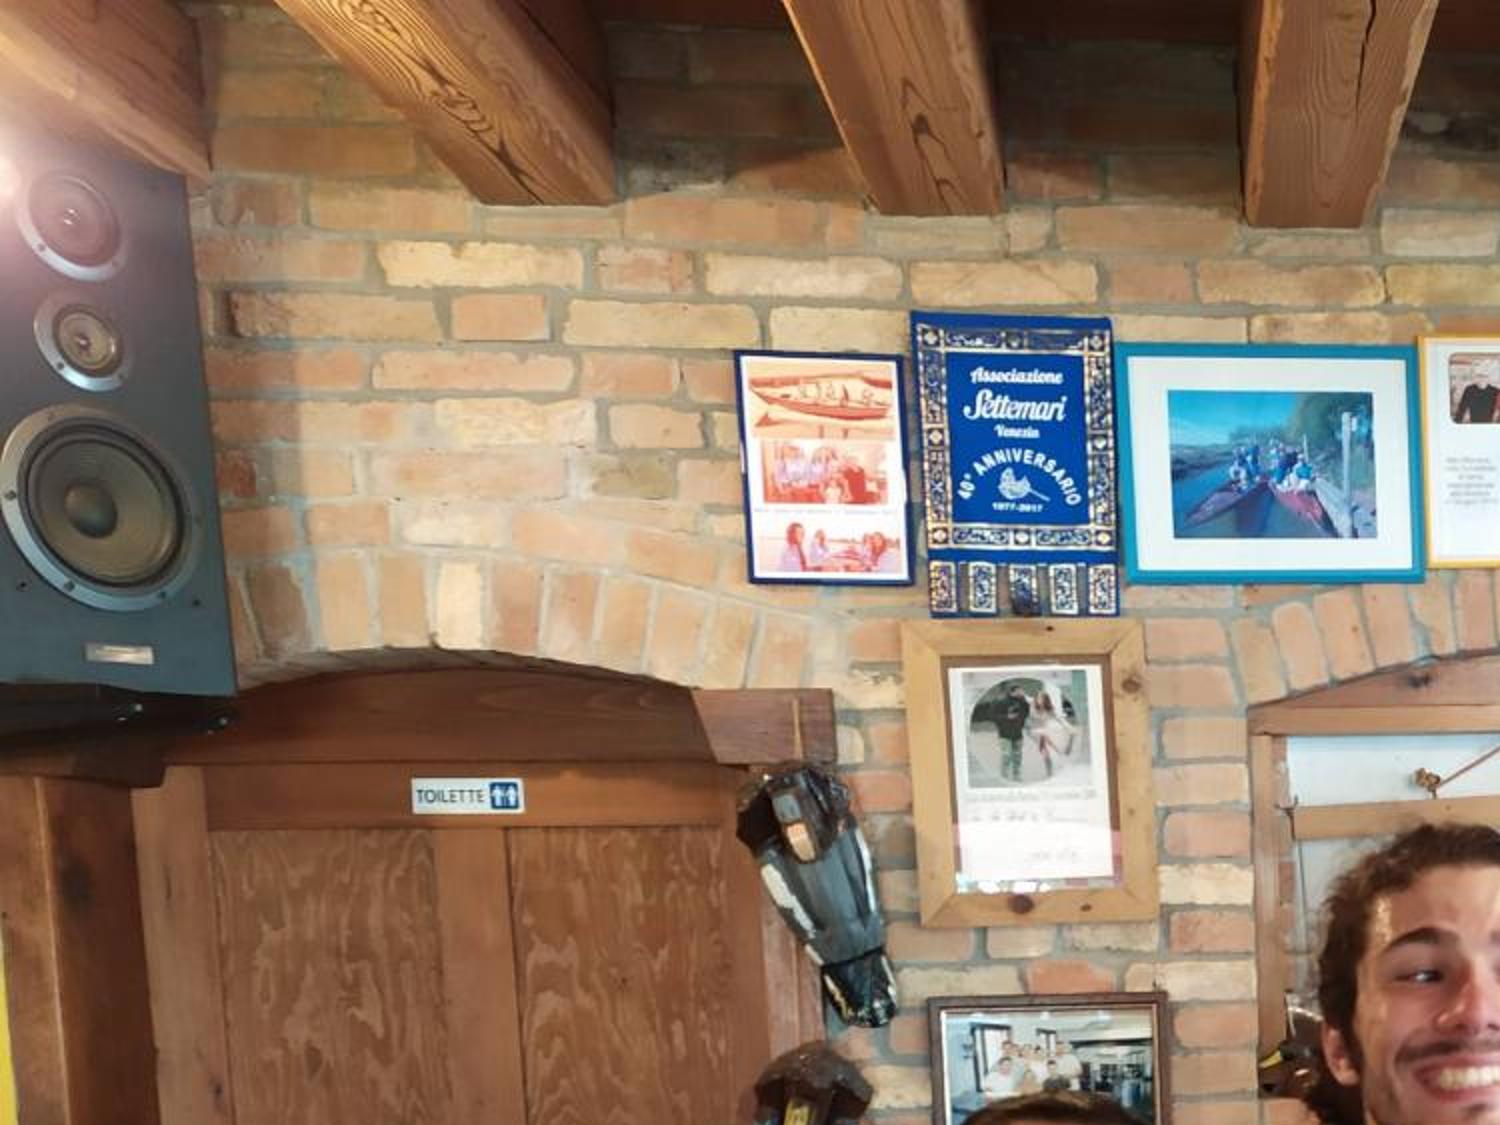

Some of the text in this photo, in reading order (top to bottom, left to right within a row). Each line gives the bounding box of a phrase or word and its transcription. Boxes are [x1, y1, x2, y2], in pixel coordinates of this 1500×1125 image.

[970, 366, 1064, 384] Associazione
[963, 389, 1068, 422] Settemari
[972, 448, 1082, 505] ANNIVERSARIO
[416, 789, 485, 804] TOILETTE
